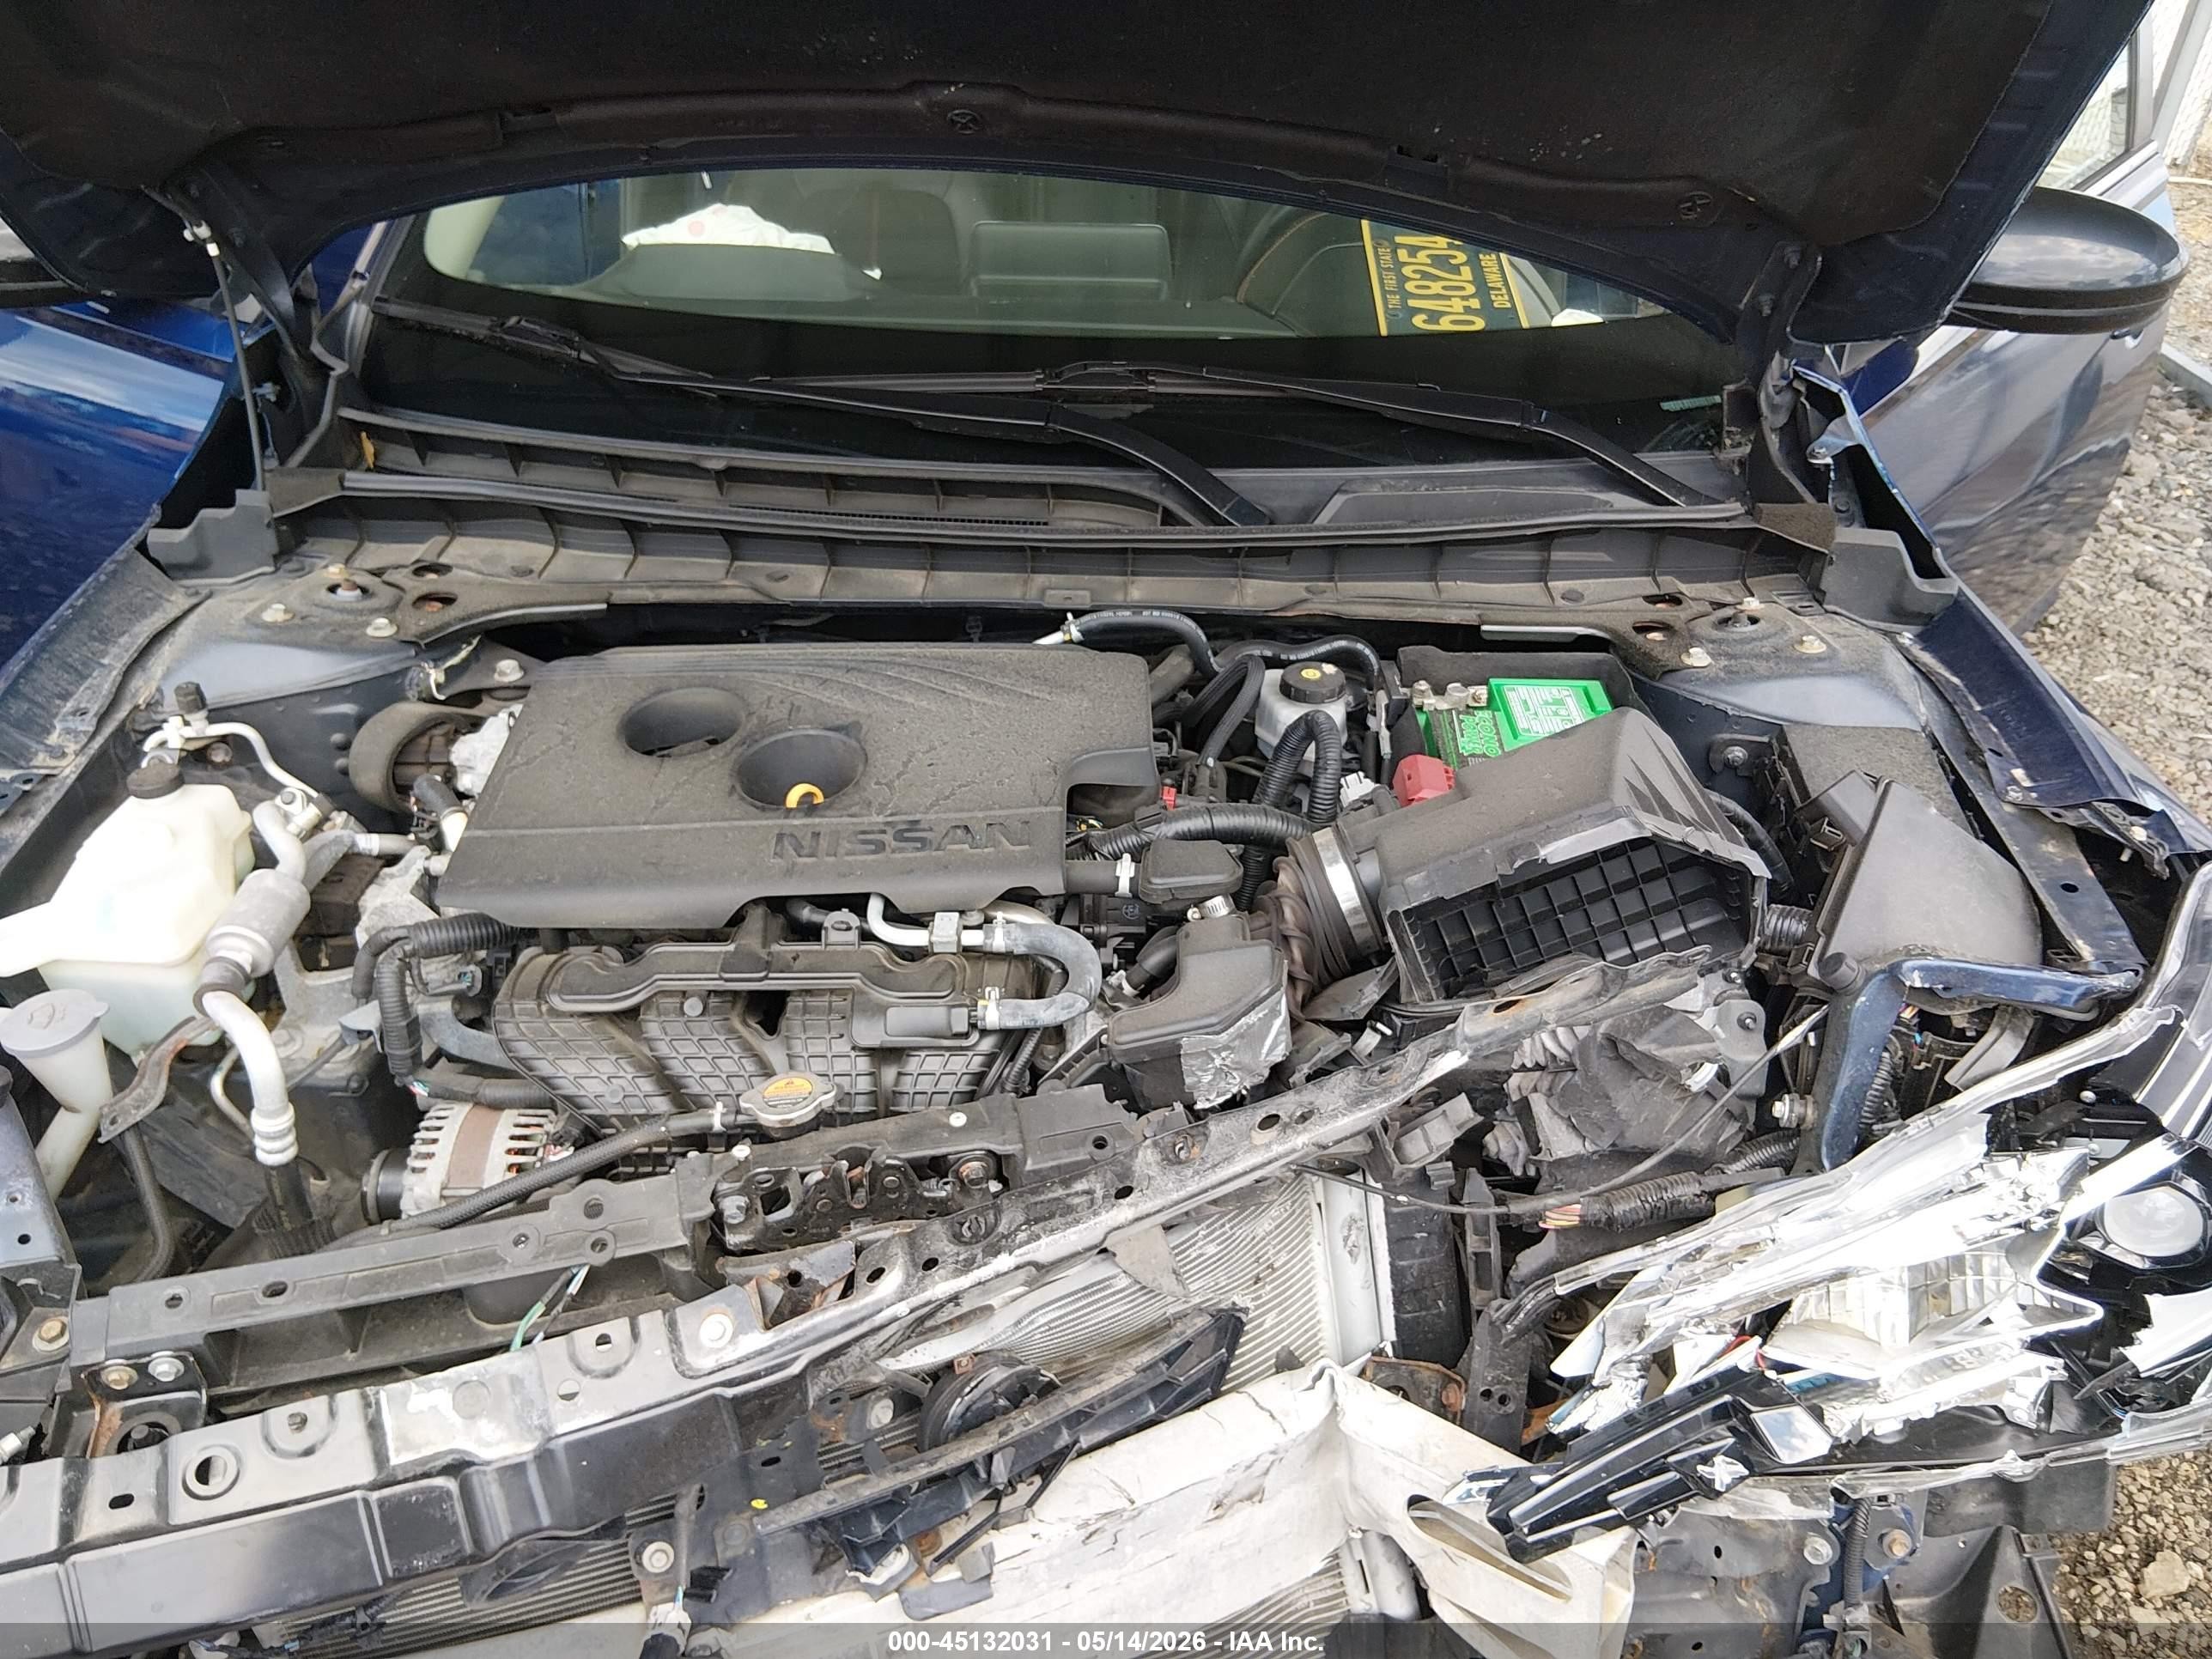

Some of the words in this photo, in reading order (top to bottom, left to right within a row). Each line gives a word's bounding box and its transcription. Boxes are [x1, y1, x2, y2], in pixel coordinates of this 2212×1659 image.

[1377, 247, 1393, 268] STATE
[1382, 271, 1398, 291] FIRST
[1394, 234, 1486, 331] 648254
[1479, 253, 1512, 308] DELAWARE
[1386, 295, 1401, 309] THE
[1474, 710, 1501, 757] ECONO
[770, 821, 1030, 861] NISSAN
